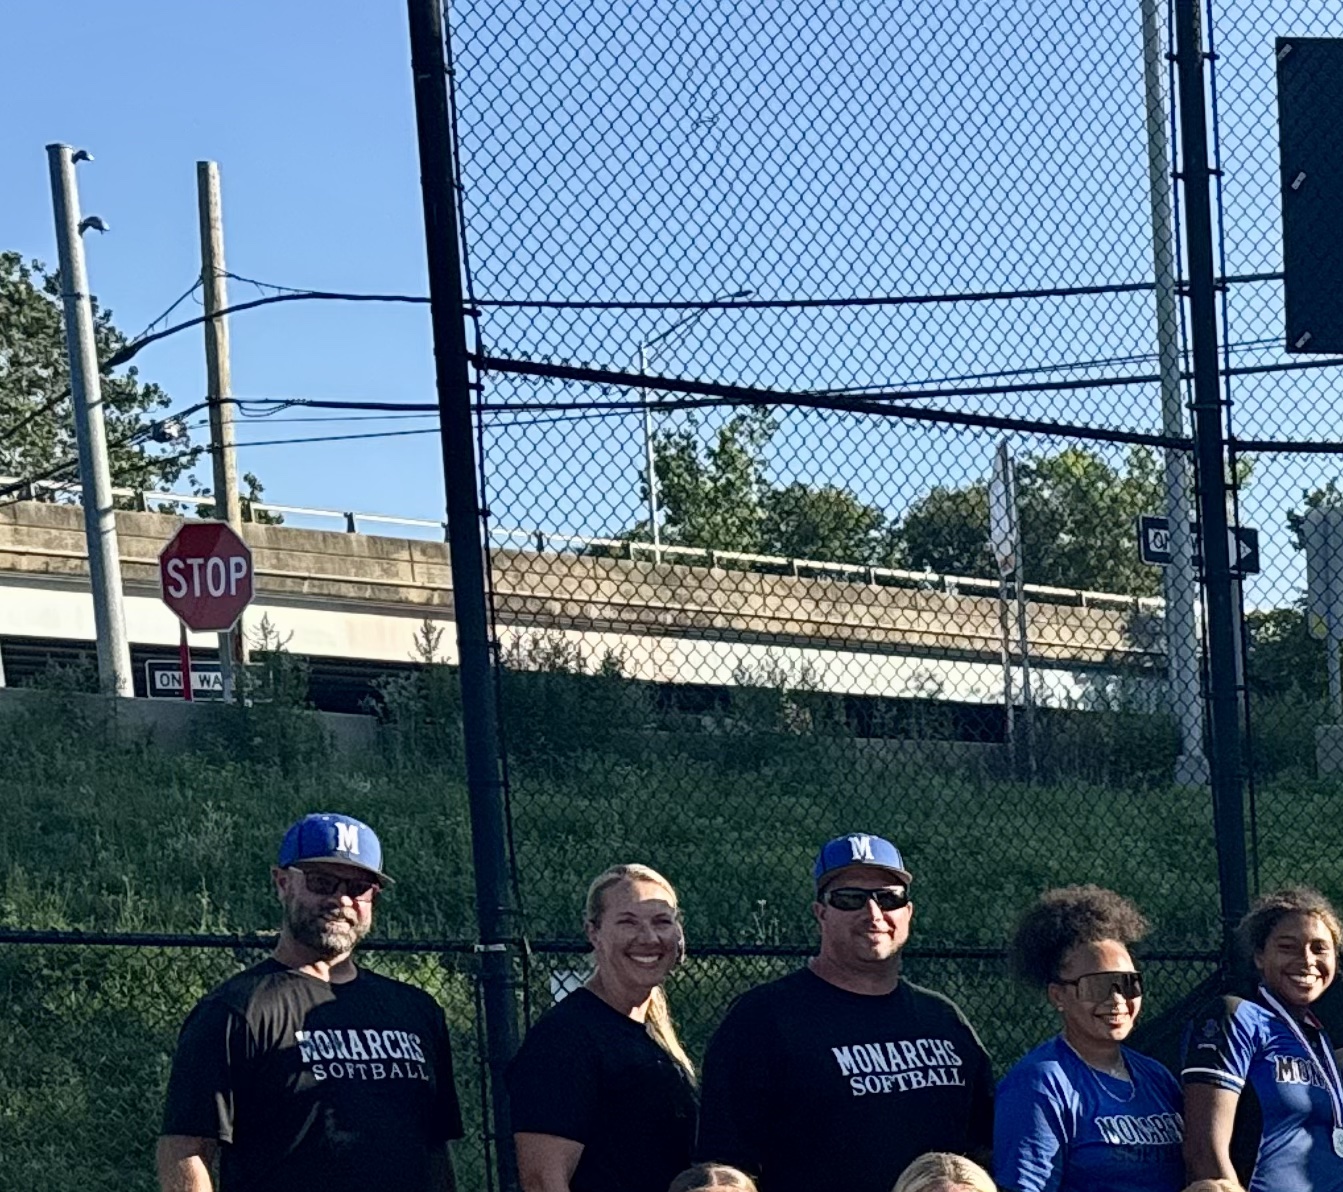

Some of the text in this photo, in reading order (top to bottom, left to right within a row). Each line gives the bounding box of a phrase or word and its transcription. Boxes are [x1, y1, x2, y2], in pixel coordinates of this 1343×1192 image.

[166, 556, 248, 599] STOP
[159, 672, 224, 688] ON WA
[335, 822, 360, 855] M
[848, 835, 874, 862] M
[295, 1028, 426, 1064] MONARCHS
[831, 1038, 963, 1077] MONARCHS
[312, 1062, 430, 1082] SOFTBALL
[849, 1066, 966, 1097] SOFTBALL
